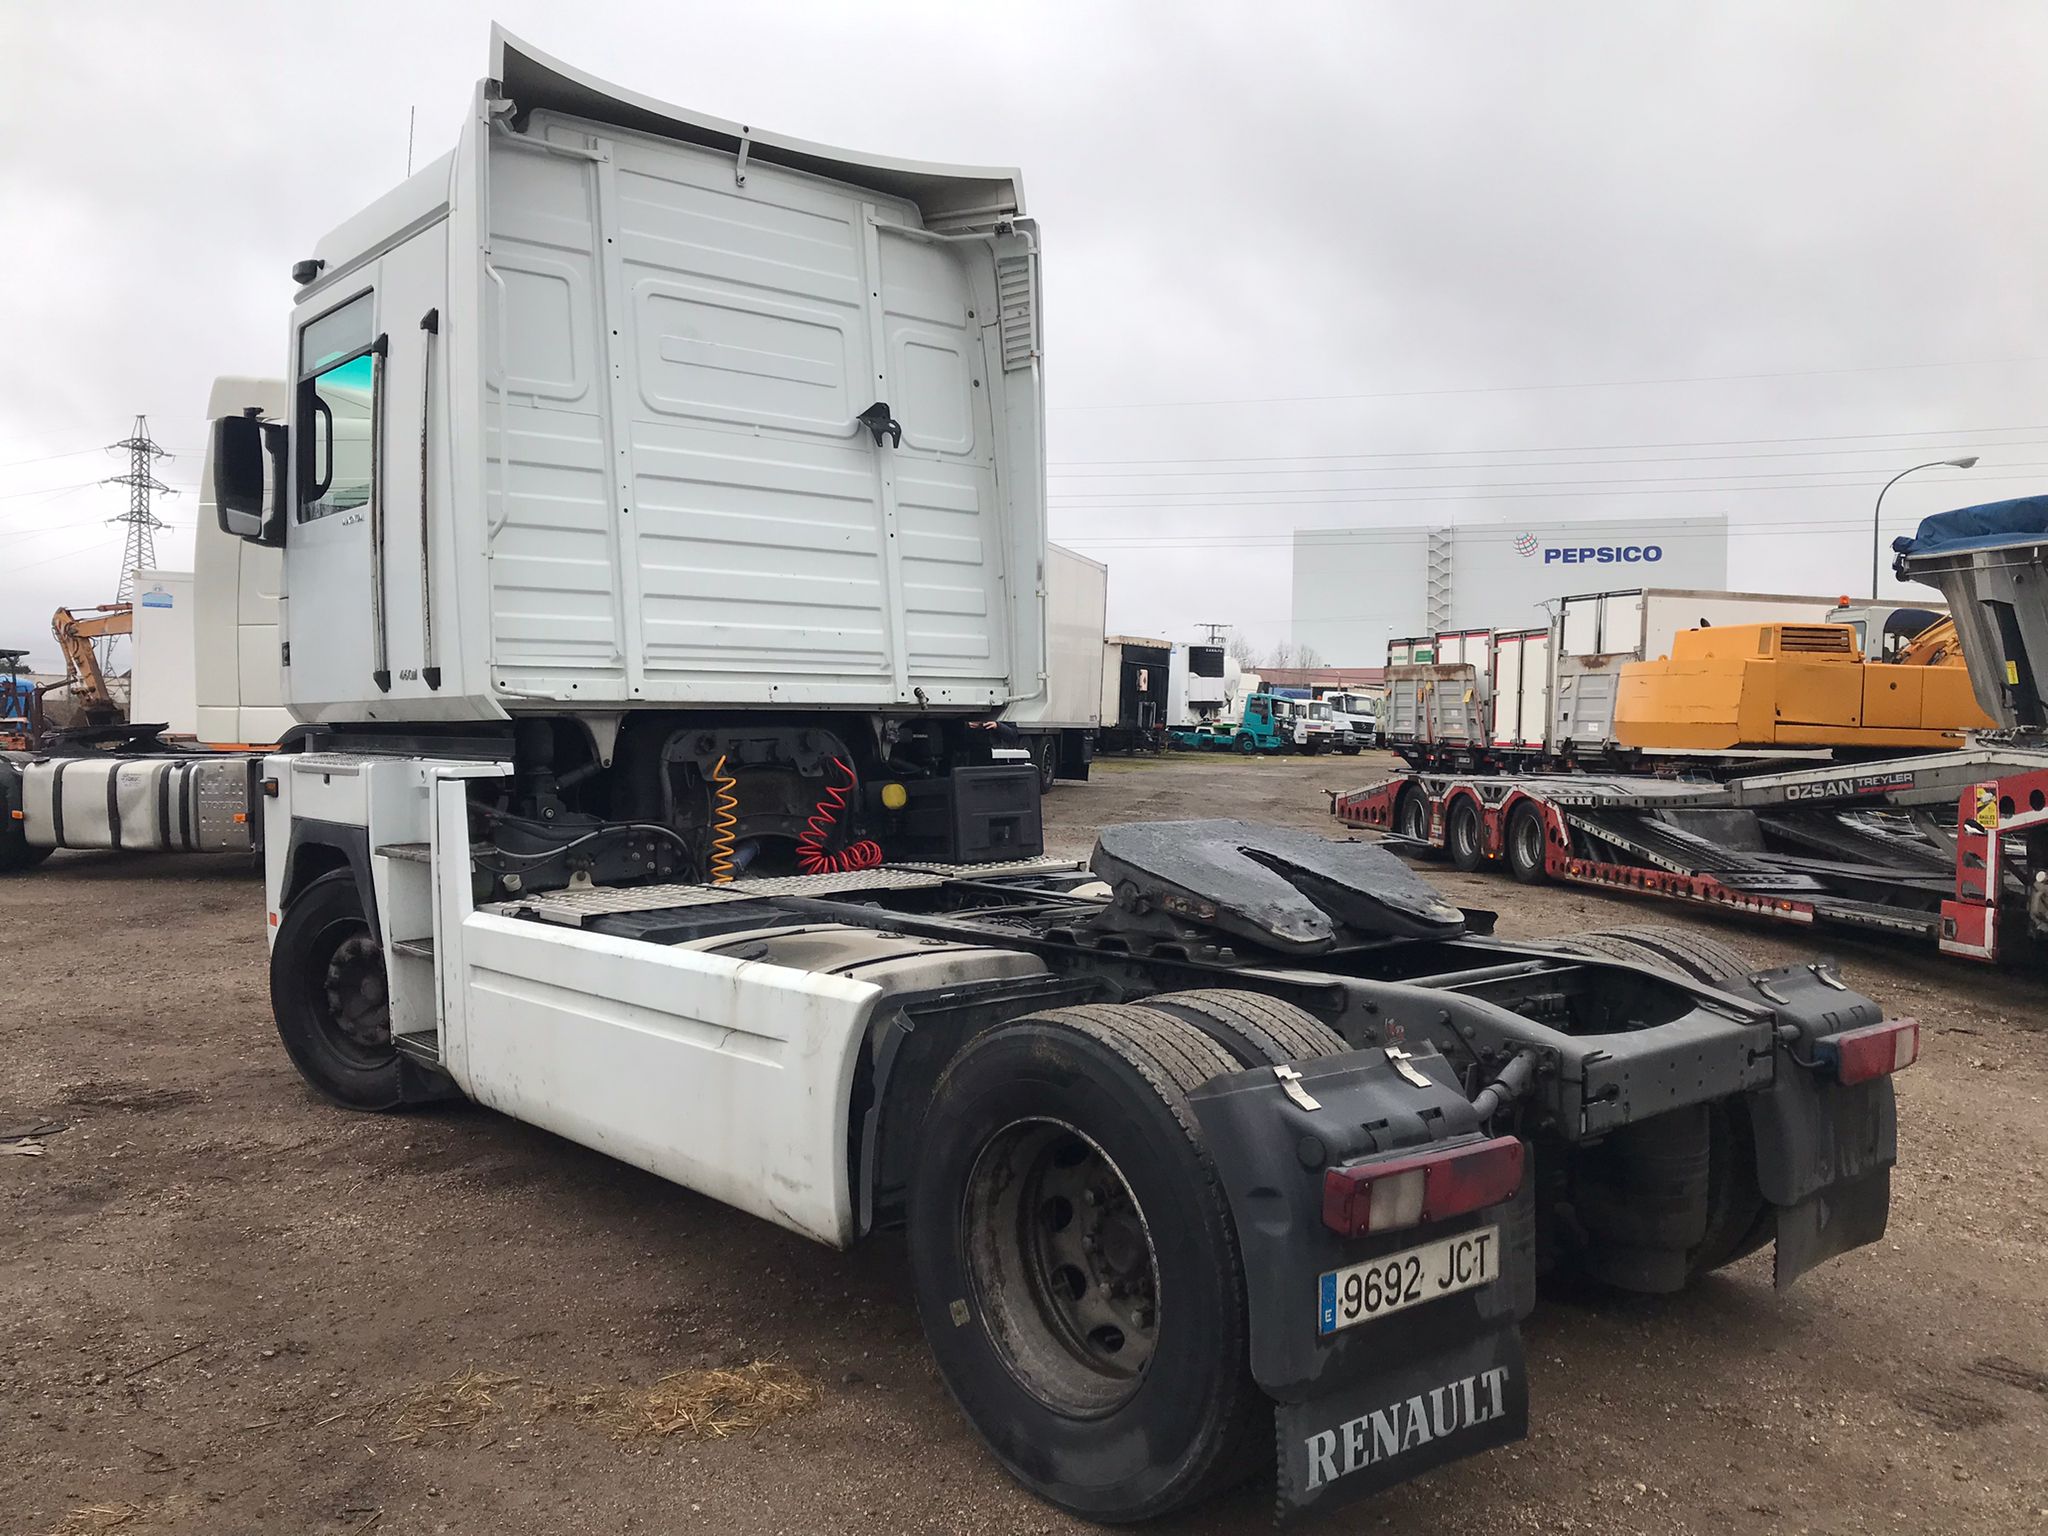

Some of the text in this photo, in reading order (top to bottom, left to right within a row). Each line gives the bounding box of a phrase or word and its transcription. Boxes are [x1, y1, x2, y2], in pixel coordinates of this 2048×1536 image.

[1544, 545, 1663, 564] PEPSICO
[1786, 773, 1913, 800] OZSAN TREYLER
[1325, 1234, 1490, 1322] E 9692 JCT
[1304, 1365, 1509, 1492] RENAULT
